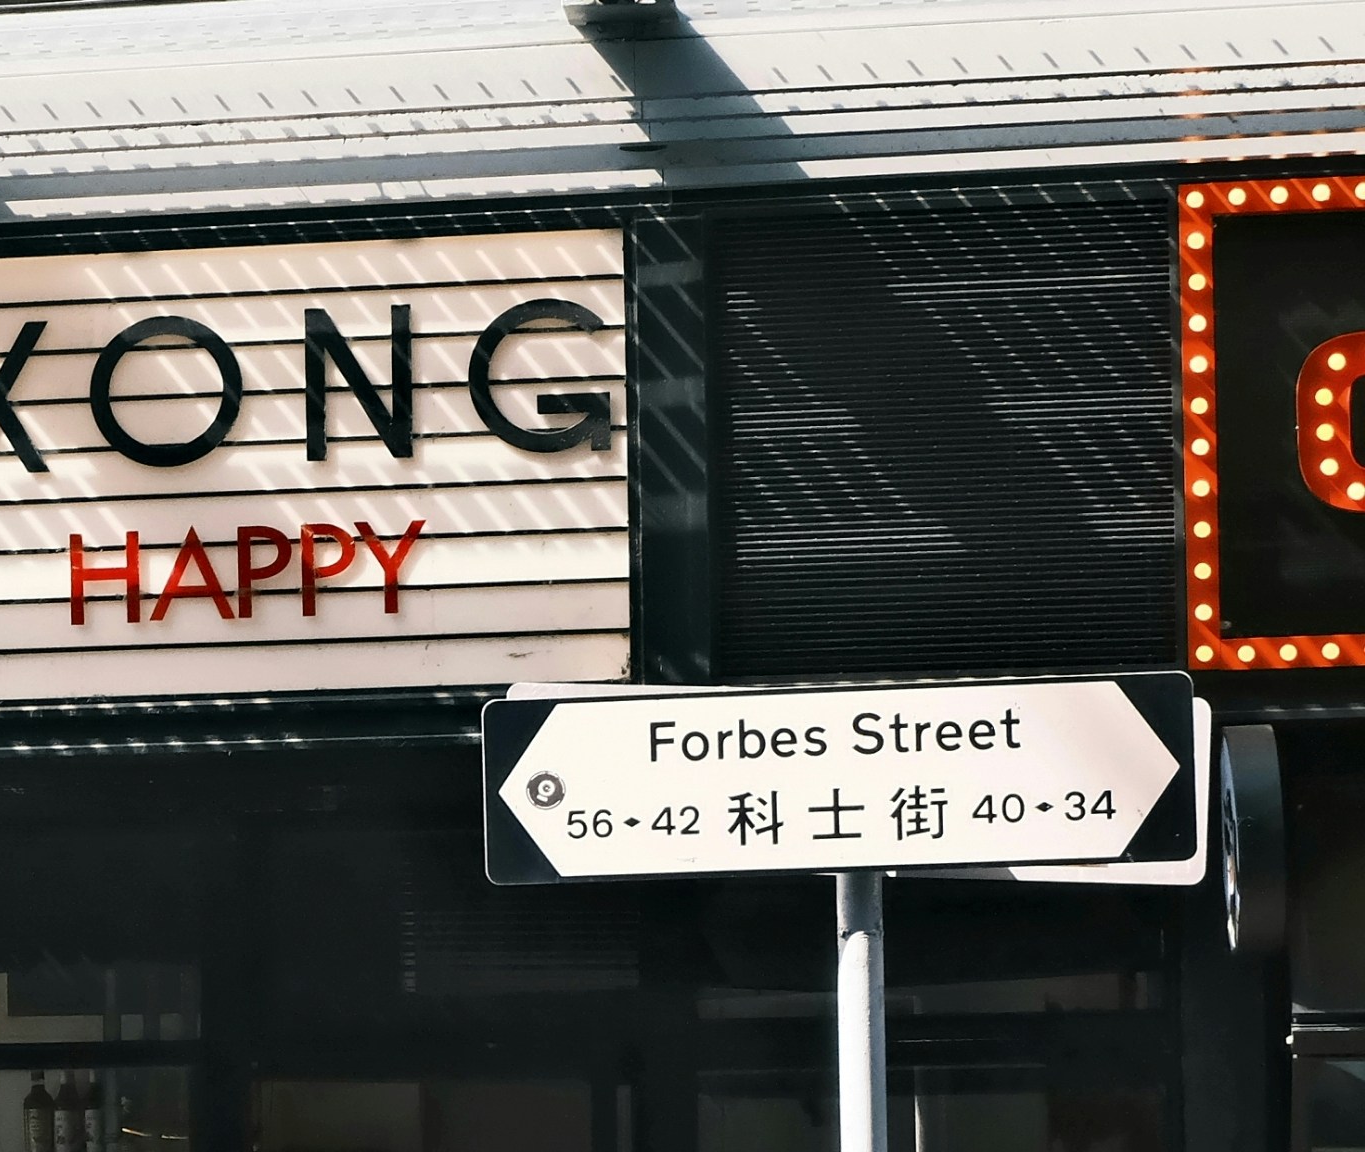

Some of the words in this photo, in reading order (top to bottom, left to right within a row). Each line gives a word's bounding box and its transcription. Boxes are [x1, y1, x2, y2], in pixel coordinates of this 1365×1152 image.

[69, 518, 427, 627] HAPPY
[649, 717, 828, 763] Forbes
[851, 707, 1021, 756] Street
[727, 784, 947, 846] 科士街
